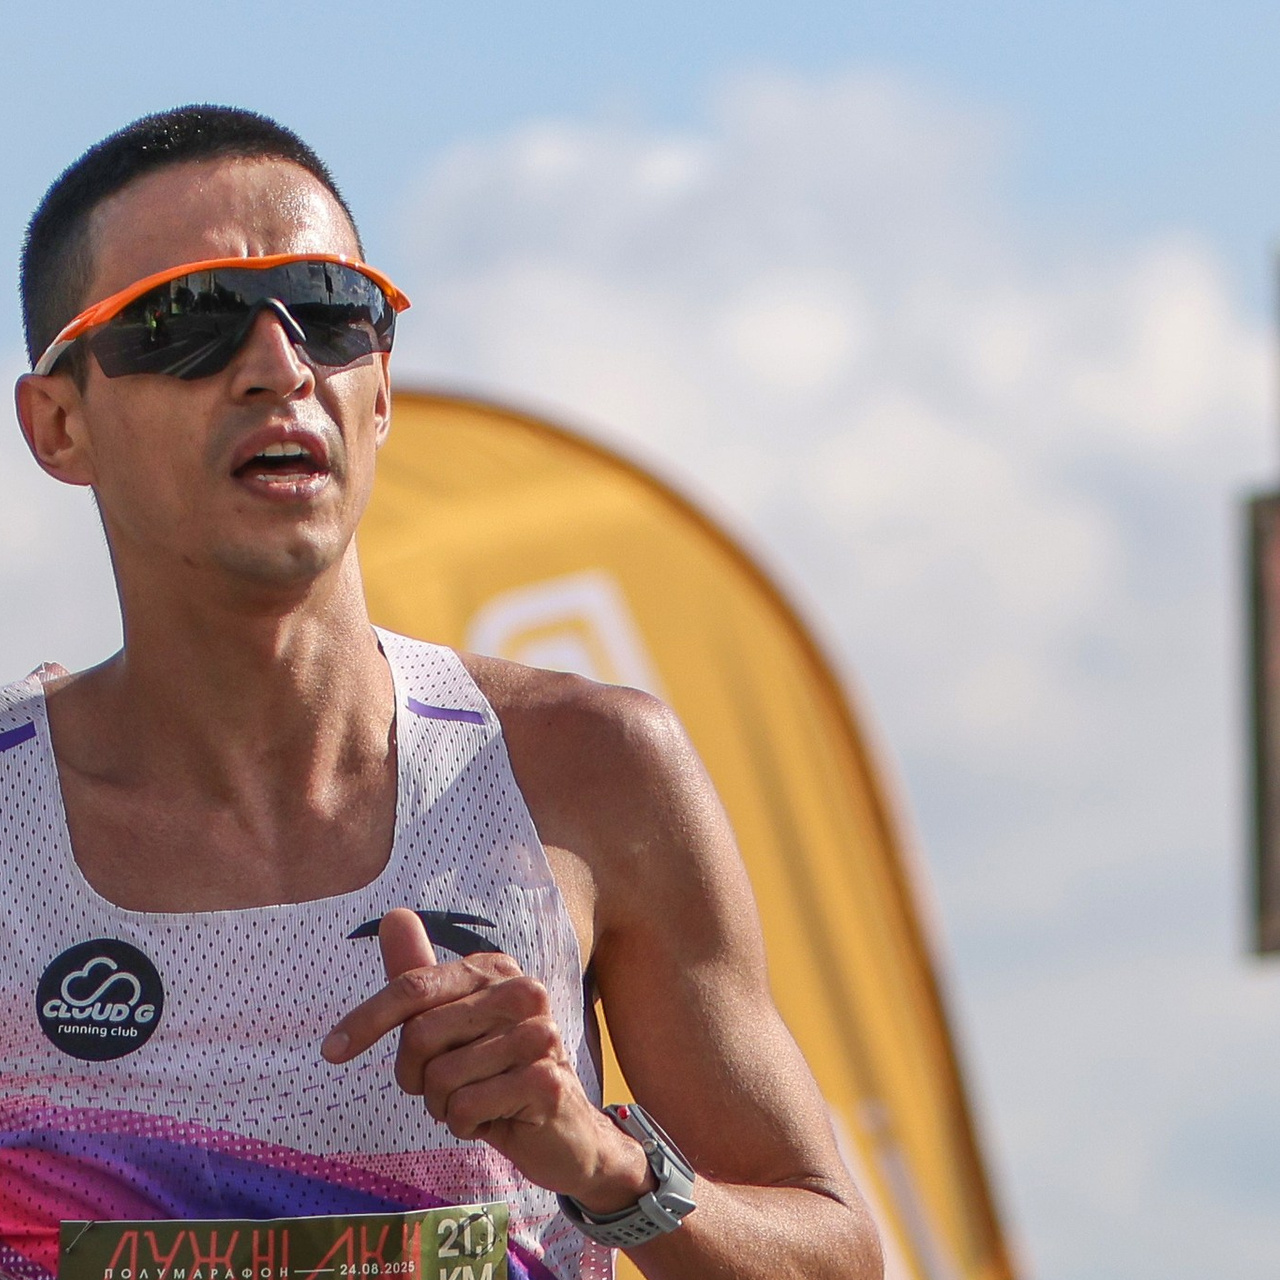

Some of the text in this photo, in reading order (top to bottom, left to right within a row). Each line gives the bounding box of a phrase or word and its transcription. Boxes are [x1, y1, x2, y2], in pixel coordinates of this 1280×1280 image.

[43, 999, 155, 1023] CLOUD G
[58, 1024, 138, 1037] running club
[104, 1261, 415, 1280] ПОЛУМАРАФОН 24.08.2025
